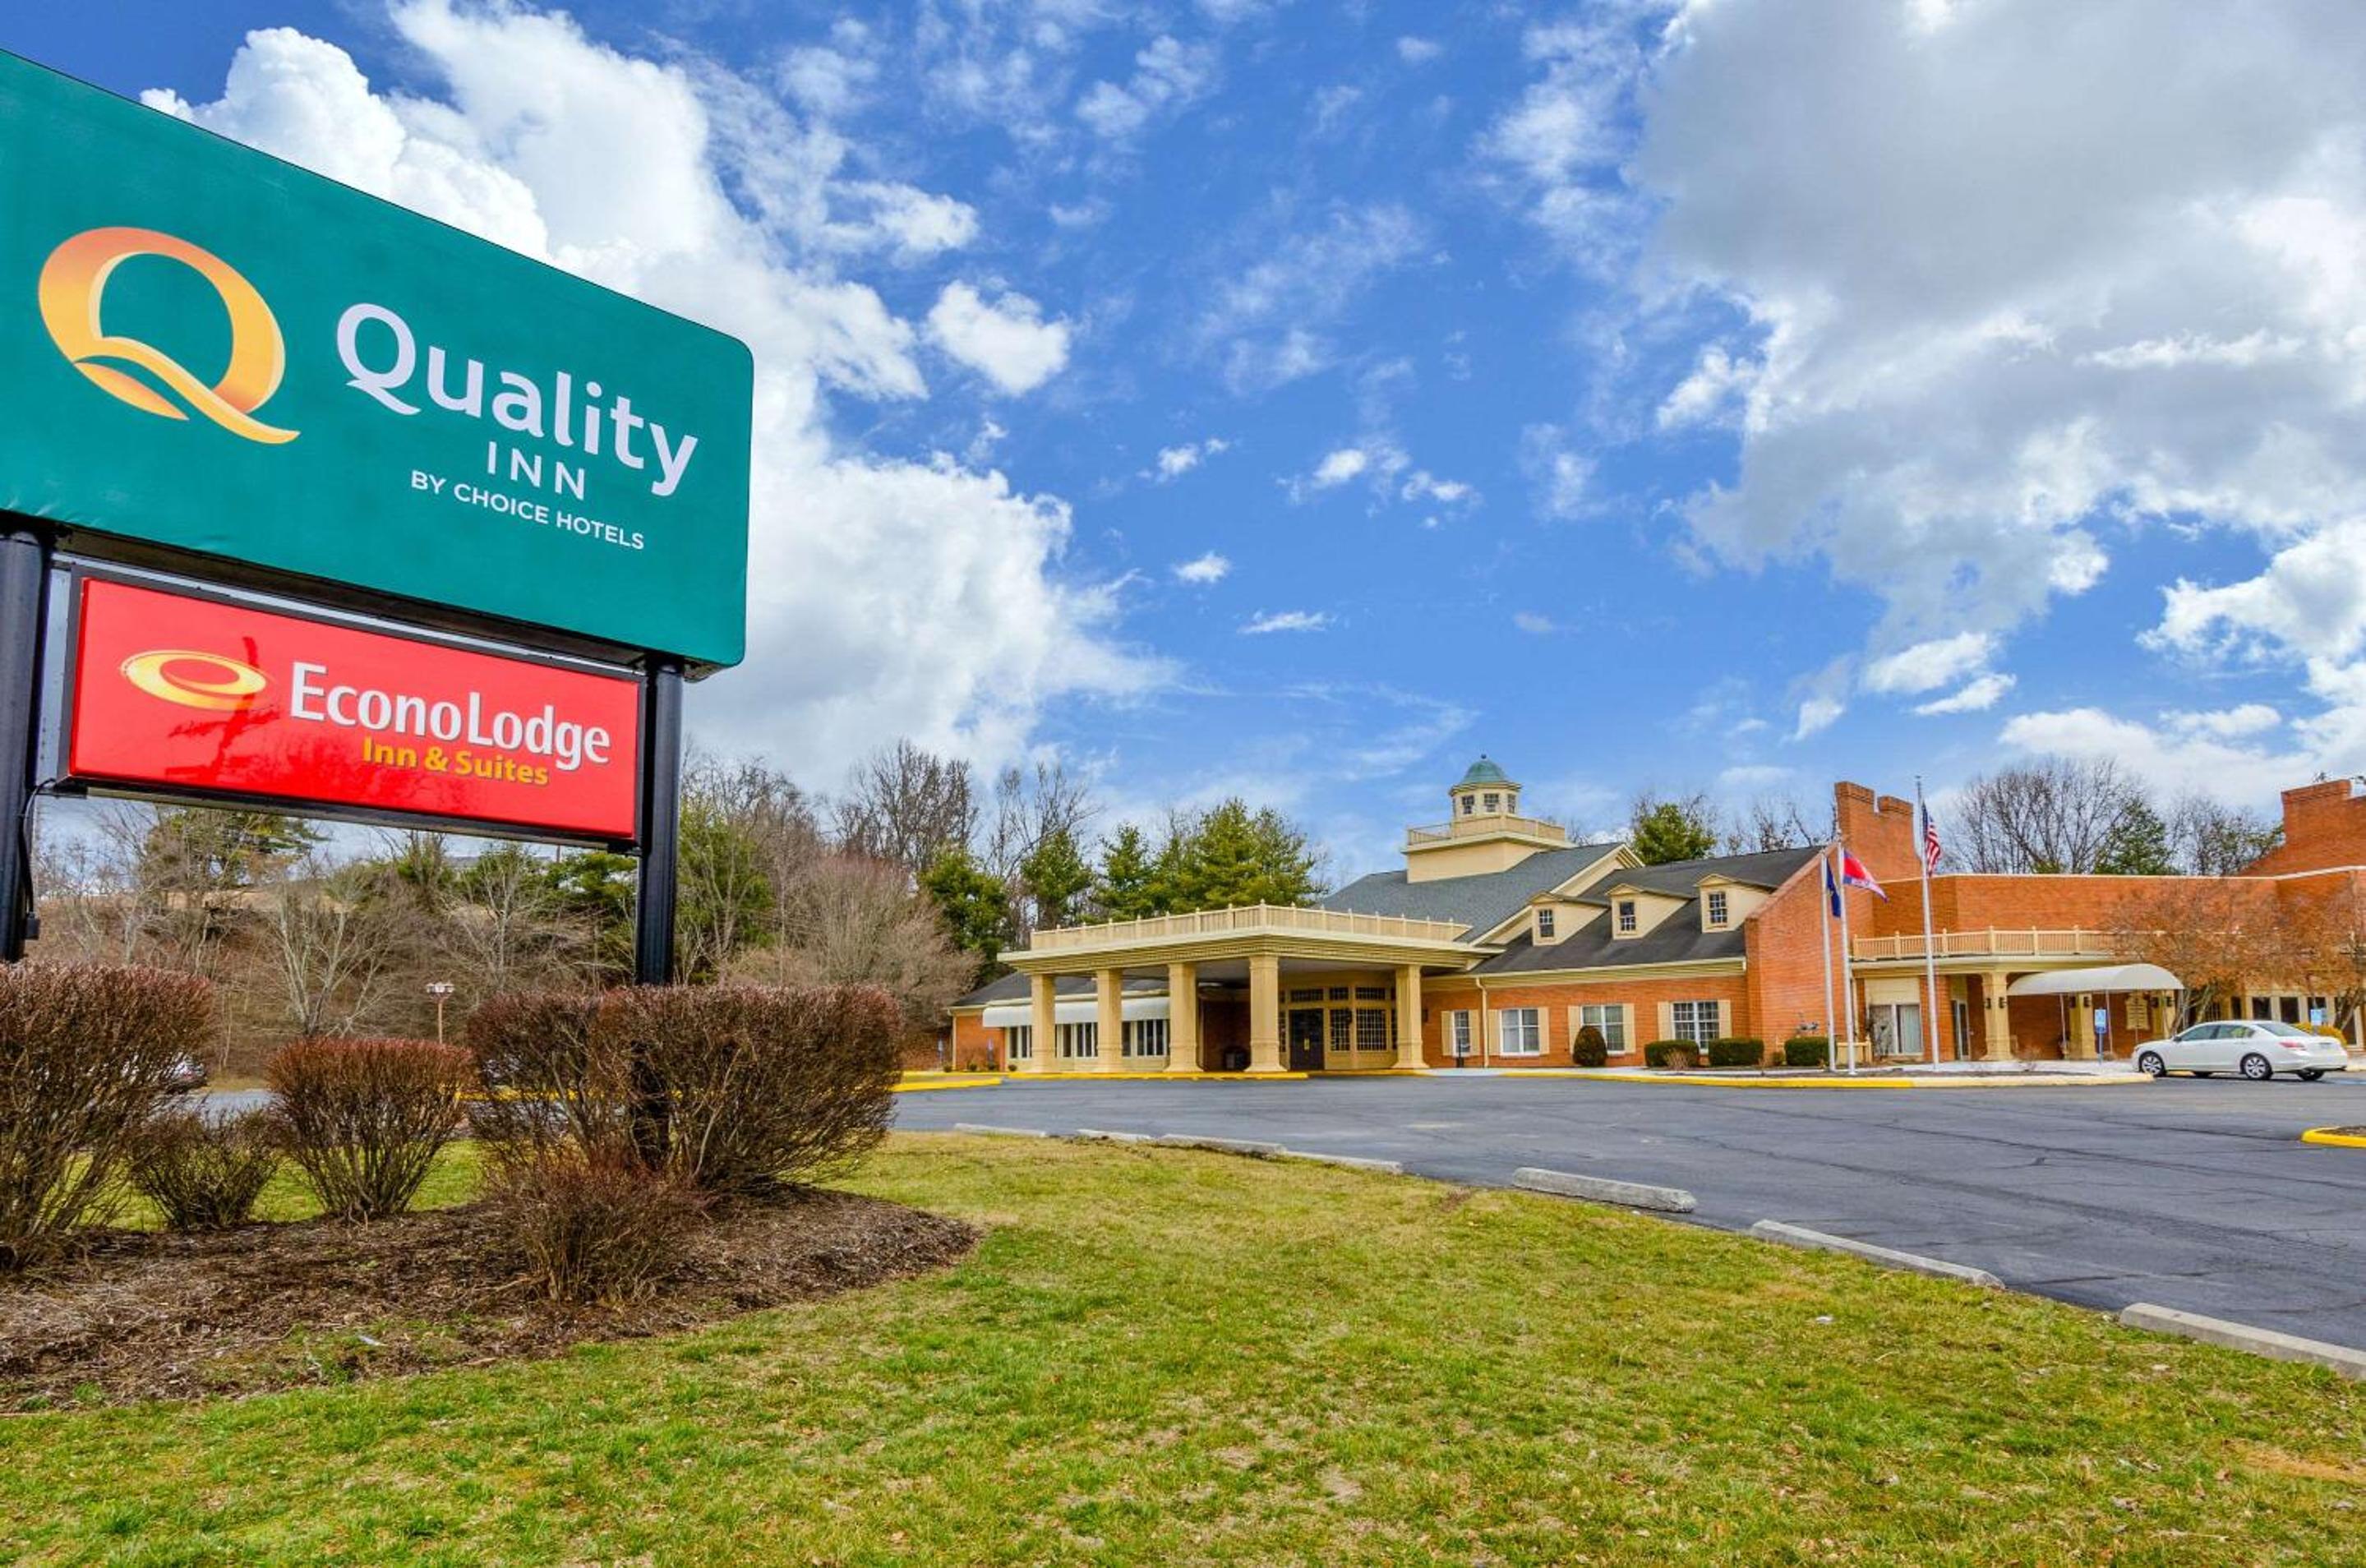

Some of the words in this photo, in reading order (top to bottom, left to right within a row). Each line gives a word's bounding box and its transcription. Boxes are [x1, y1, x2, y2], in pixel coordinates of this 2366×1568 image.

[336, 302, 699, 497] Quality
[410, 469, 446, 495] BY
[453, 482, 550, 525] CHOICE
[555, 511, 645, 550] HOTELS
[487, 440, 586, 501] INN
[290, 661, 611, 772] EconoLodge
[362, 736, 418, 769] Inn
[423, 745, 451, 772] &
[454, 749, 550, 786] Suites
